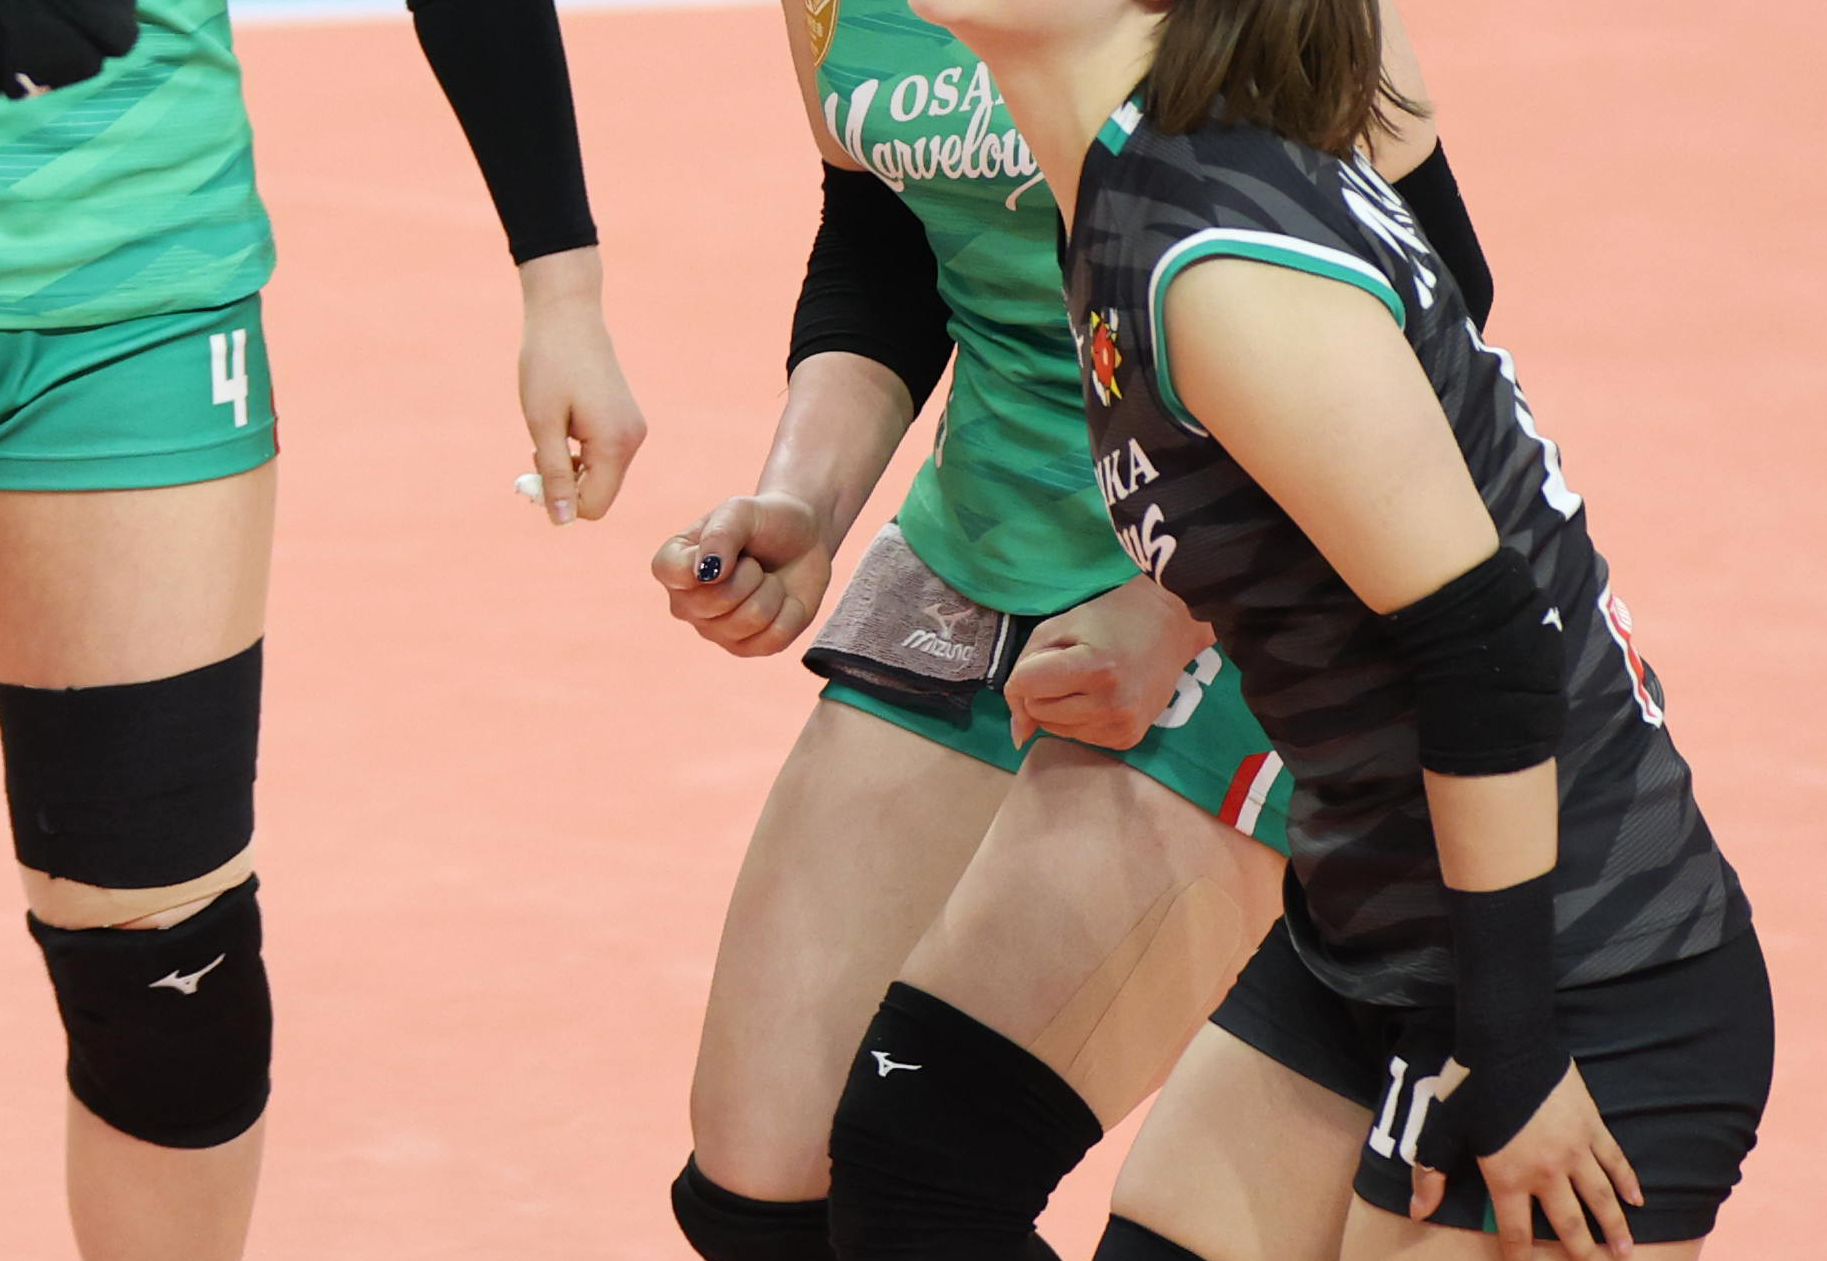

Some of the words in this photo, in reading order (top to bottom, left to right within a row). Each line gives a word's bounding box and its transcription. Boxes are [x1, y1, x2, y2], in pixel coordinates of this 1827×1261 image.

[890, 61, 1005, 122] OSA
[824, 79, 1046, 211] Marvelou
[209, 327, 250, 428] 4
